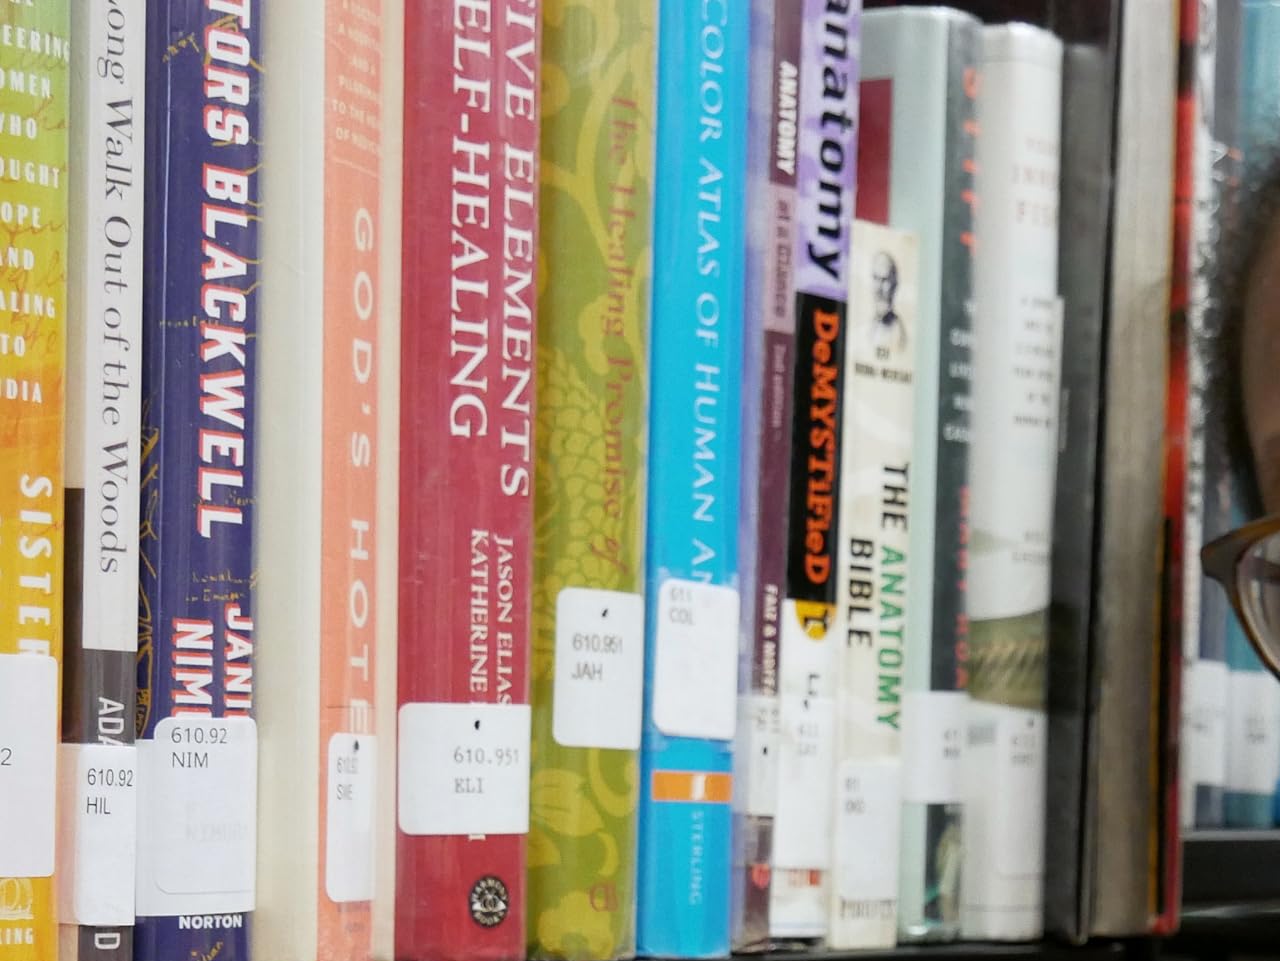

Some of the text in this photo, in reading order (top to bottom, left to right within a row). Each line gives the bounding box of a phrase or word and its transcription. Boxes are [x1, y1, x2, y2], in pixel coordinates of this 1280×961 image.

[700, 0, 729, 143] COLOR
[777, 60, 798, 176] ANATOMY
[500, 0, 537, 497] IVE ELEMENTS
[697, 156, 725, 279] ATLAS
[97, 0, 134, 575] ong Walk Out of the Woods
[589, 95, 637, 575] The Healing Promise of
[695, 292, 721, 349] OF
[0, 334, 26, 357] TO
[0, 378, 43, 403] DIA
[198, 162, 249, 539] BLACKWELL
[348, 207, 374, 735] GOD'S HOTE
[692, 362, 722, 522] HUMAN
[469, 528, 490, 692] KATHERINE
[493, 532, 514, 706] JASON ELIAS
[572, 632, 624, 654] 610.951
[847, 537, 874, 648] BIBLE
[876, 462, 910, 731] THE ANATOMY
[171, 617, 214, 719] NIM
[224, 602, 254, 718] JANI
[571, 663, 604, 680] JAH
[98, 697, 125, 748] ADA
[171, 727, 228, 744] 610.92
[172, 752, 209, 768] NIM
[454, 746, 520, 766] 610.951
[86, 797, 111, 815] HIL
[87, 768, 134, 787] 610.92
[454, 777, 485, 793] ELI
[179, 914, 243, 930] NORTON
